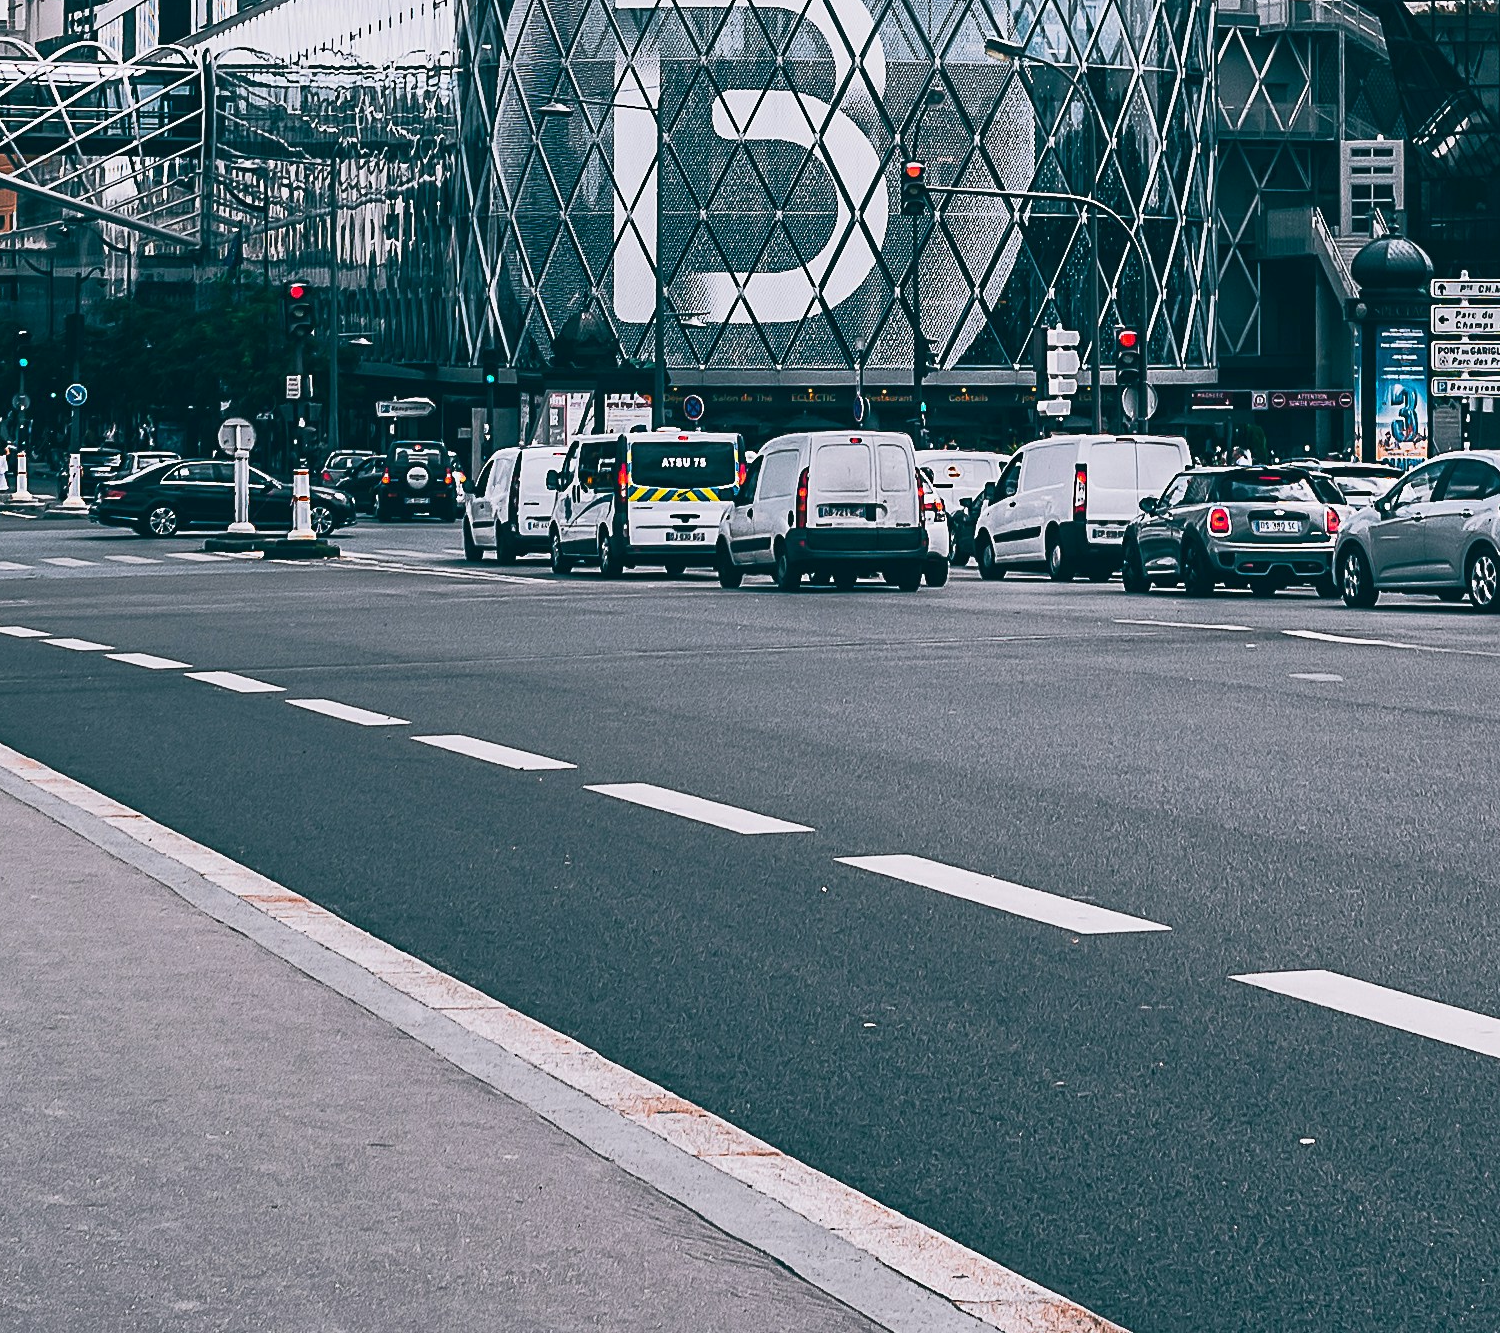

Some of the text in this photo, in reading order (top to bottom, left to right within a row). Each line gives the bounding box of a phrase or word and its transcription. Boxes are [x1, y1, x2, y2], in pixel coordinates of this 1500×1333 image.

[1455, 311, 1493, 319] Parc du
[1455, 321, 1494, 330] Champs
[1437, 346, 1461, 355] PONT
[1451, 357, 1472, 366] Parc
[1473, 357, 1488, 366] des
[1391, 384, 1419, 442] 3
[661, 457, 707, 468] ATSU 75
